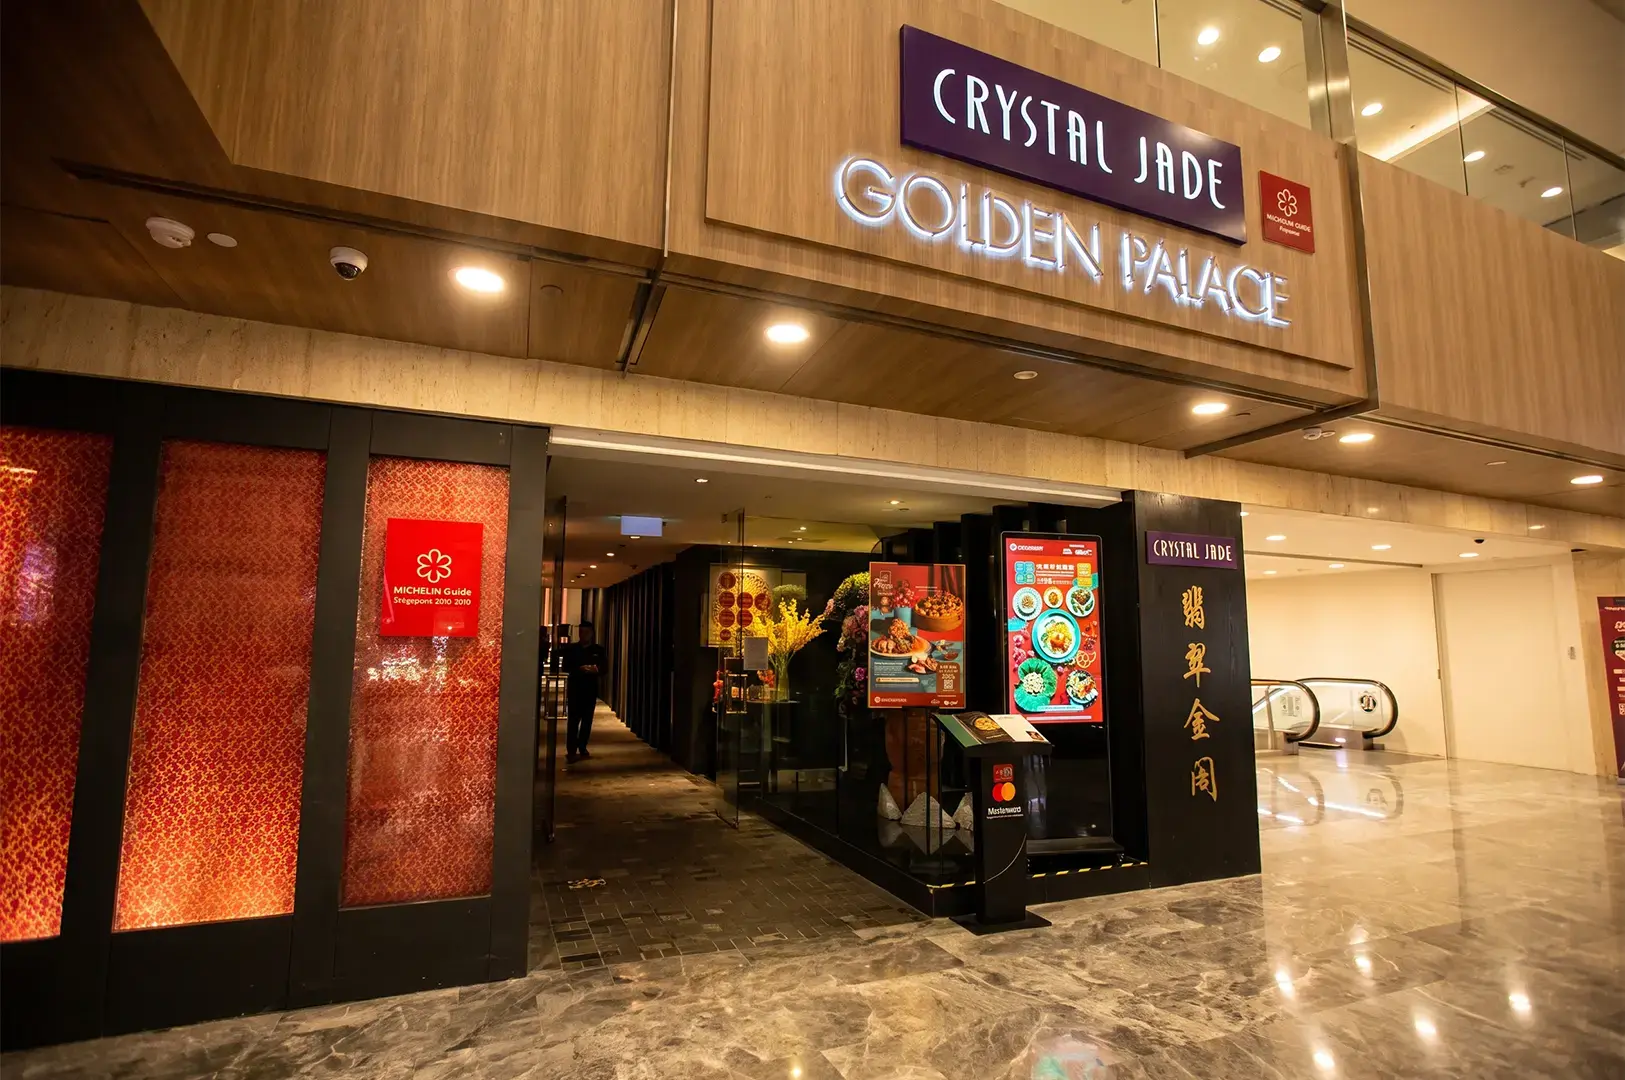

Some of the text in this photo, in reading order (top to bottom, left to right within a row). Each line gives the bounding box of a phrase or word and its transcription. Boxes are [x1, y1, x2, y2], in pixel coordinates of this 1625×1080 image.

[933, 68, 1226, 210] CRYSTAL JADE
[837, 156, 1292, 327] GOLDEN PALACE
[393, 586, 472, 596] MICHELIN Guide
[1153, 539, 1233, 562] CRYSTAL JADE
